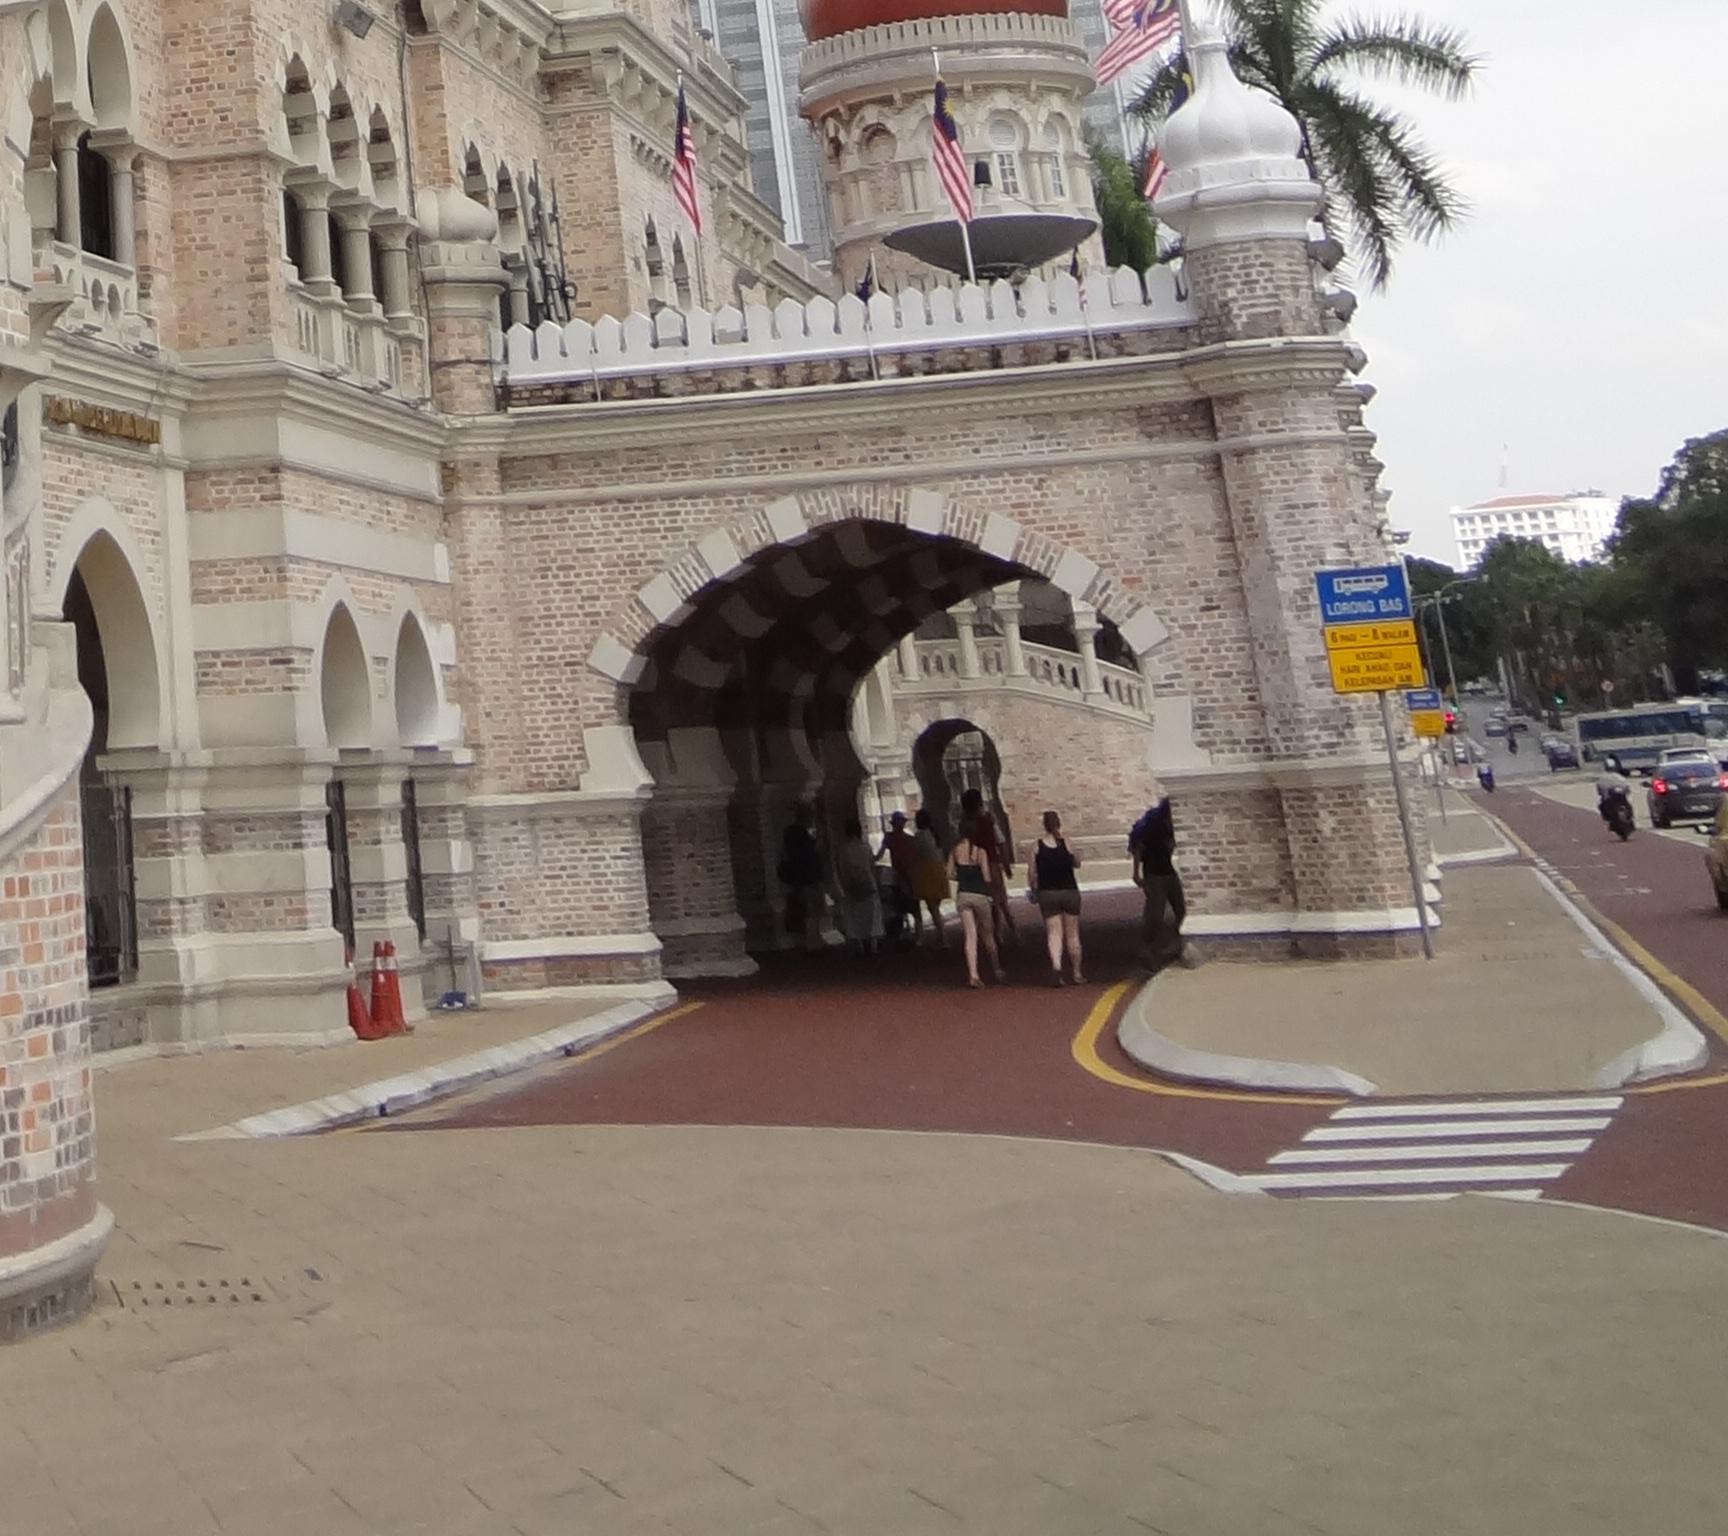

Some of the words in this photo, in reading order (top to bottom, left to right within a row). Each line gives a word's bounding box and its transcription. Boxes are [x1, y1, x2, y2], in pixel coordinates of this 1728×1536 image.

[1327, 600, 1376, 616] LORONG
[1379, 598, 1403, 612] BAS
[1331, 632, 1338, 643] 6
[1393, 662, 1412, 671] DAN
